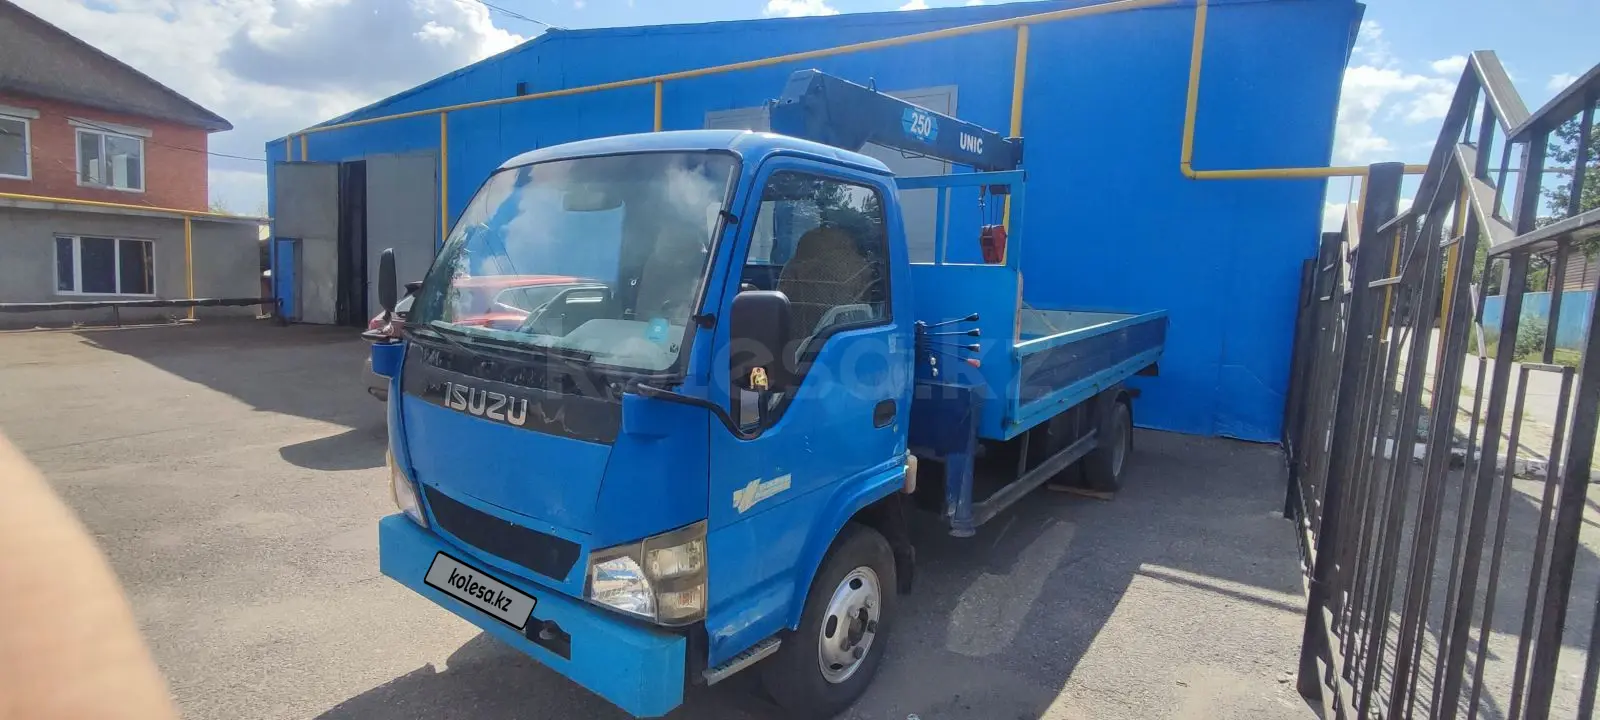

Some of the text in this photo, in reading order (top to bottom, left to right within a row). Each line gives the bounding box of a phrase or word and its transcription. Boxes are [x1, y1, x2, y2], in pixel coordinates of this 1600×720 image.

[911, 112, 931, 136] 250
[960, 131, 983, 154] UNIC
[444, 381, 528, 426] ISUZU
